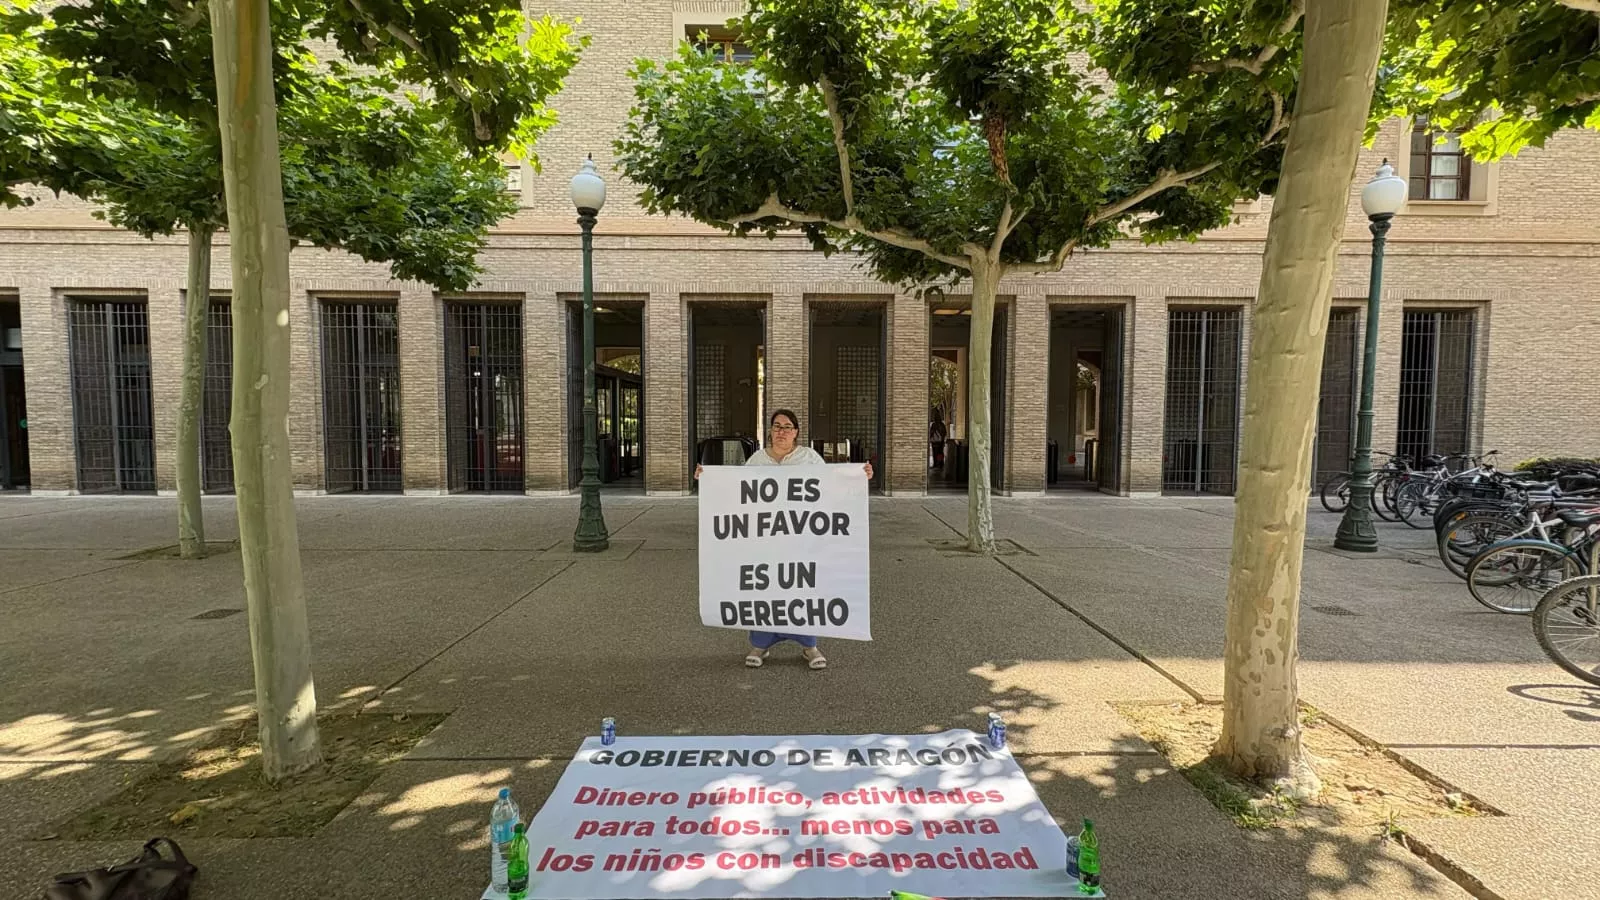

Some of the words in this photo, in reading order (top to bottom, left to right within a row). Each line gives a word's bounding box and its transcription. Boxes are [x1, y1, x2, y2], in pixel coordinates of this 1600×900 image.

[741, 478, 779, 504] NO
[787, 478, 821, 502] ES
[713, 513, 749, 540] UN
[757, 510, 850, 537] FAVOR
[740, 563, 770, 590] ES
[778, 562, 817, 589] UN
[720, 598, 849, 626] DERECHO
[589, 748, 775, 767] GOBIERNO
[788, 748, 833, 766] DE
[844, 742, 994, 766] ARAGÓN
[573, 786, 679, 806] Dinero
[688, 785, 813, 809] público,
[822, 786, 1005, 806] actividades
[575, 819, 655, 840] para
[666, 815, 790, 837] todos...
[801, 817, 913, 836] menos
[923, 818, 1001, 840] para
[536, 847, 594, 872] los
[603, 849, 706, 872] niños
[715, 851, 781, 871] con
[792, 846, 1039, 873] discapacidad
